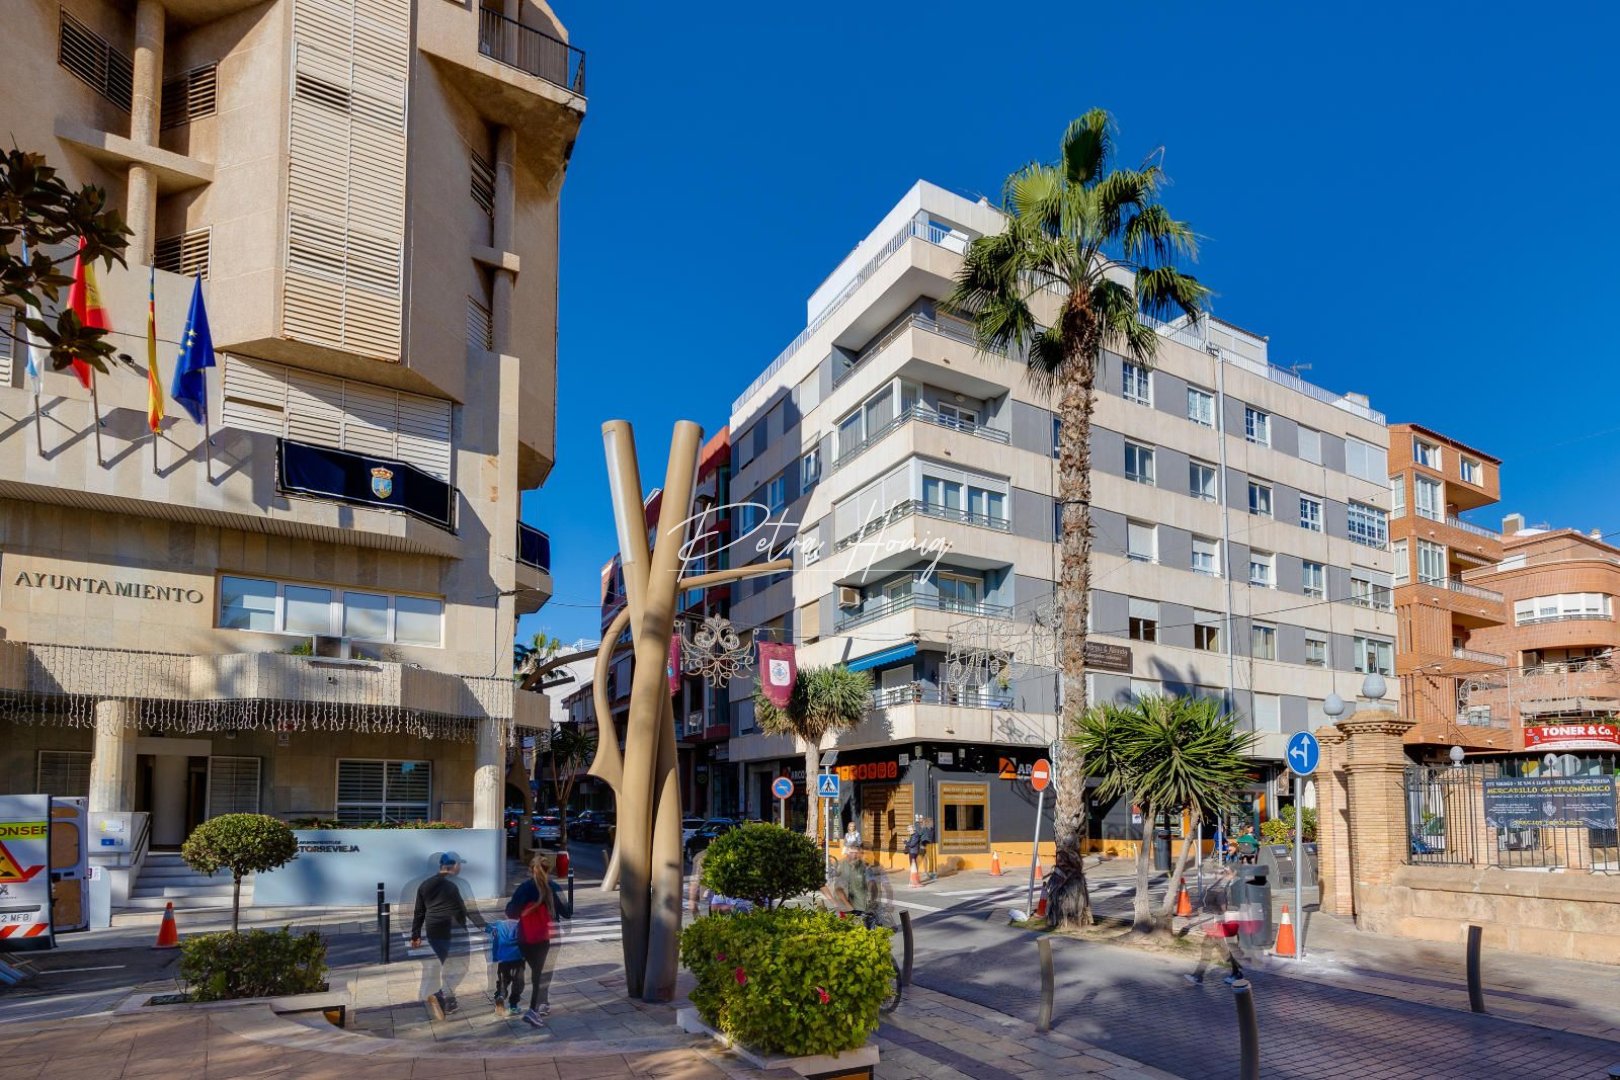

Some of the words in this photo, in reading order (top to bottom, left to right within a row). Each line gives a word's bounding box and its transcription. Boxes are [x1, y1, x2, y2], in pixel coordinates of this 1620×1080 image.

[14, 571, 203, 604] AYUNTAMIENTO
[1542, 726, 1585, 736] TONER
[1587, 725, 1597, 736] &
[1598, 725, 1613, 736] Co.
[1017, 763, 1033, 775] AR
[1541, 784, 1610, 793] GASTRONÓMICO
[299, 845, 360, 853] TORREVIEJA
